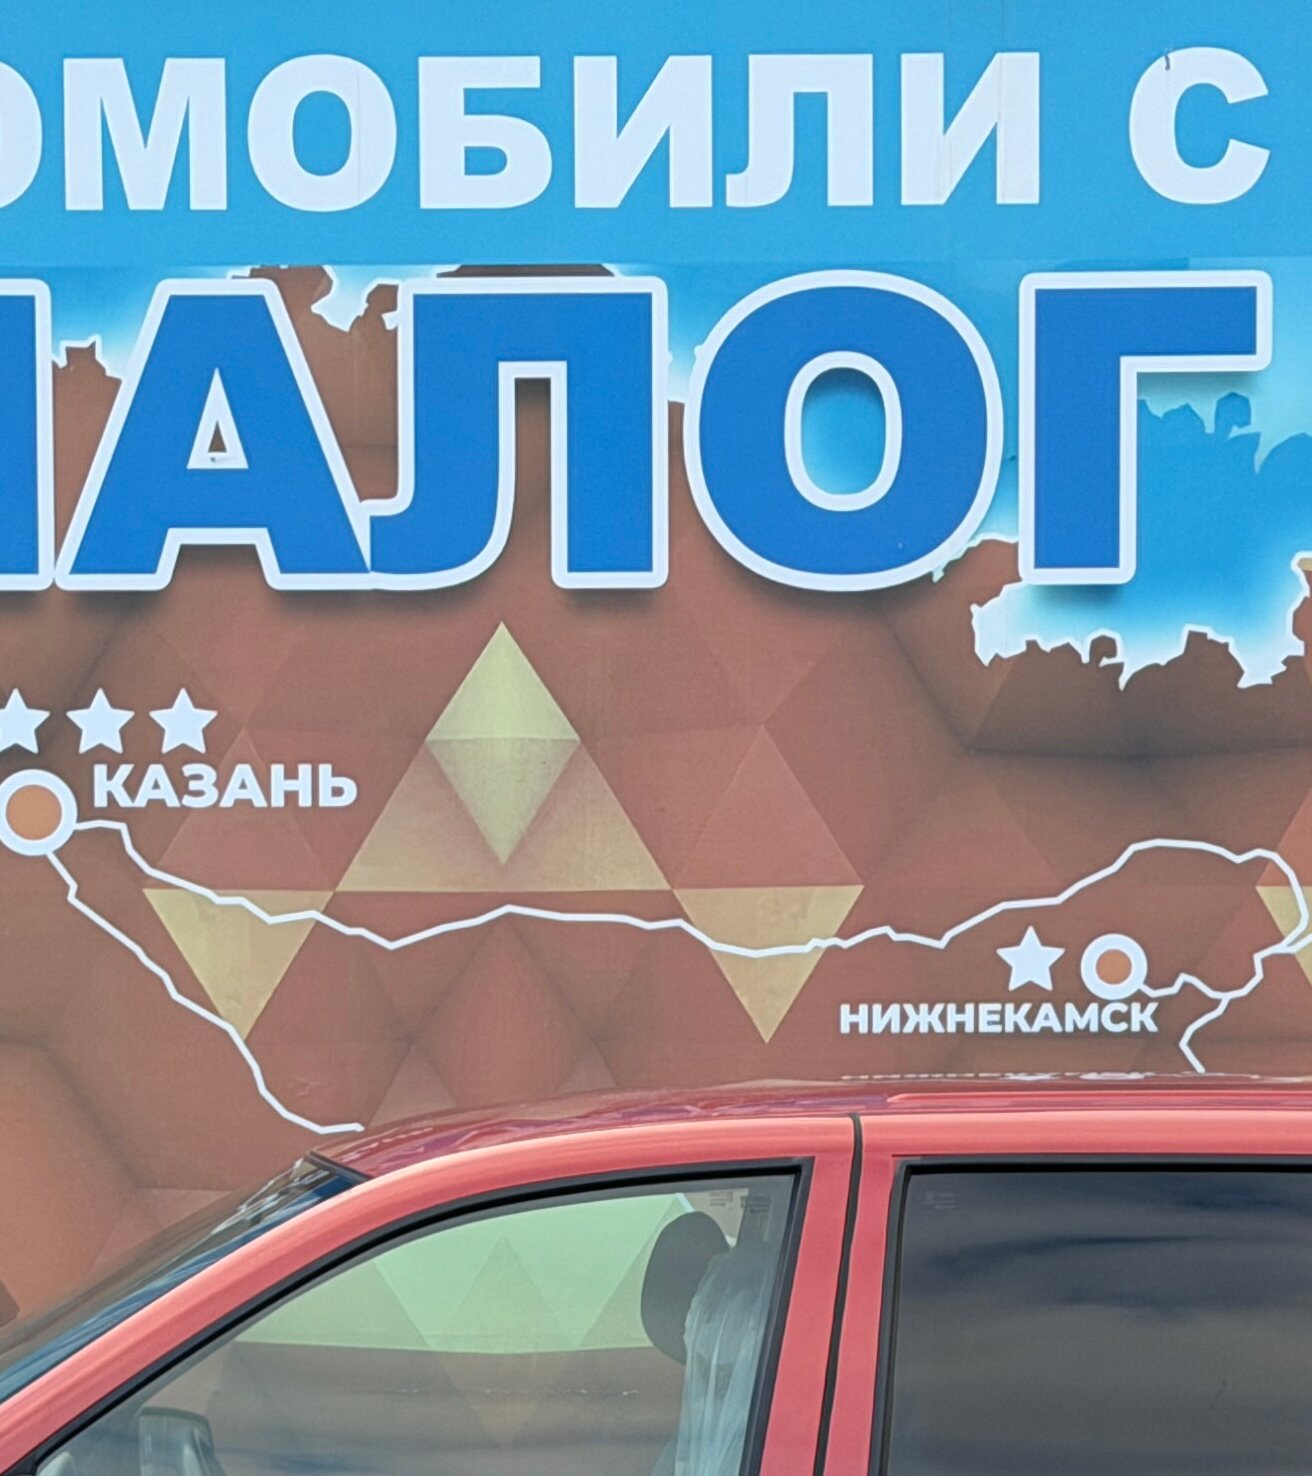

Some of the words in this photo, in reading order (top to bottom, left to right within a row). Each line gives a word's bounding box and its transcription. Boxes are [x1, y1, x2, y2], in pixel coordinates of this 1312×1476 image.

[1129, 48, 1270, 204] С
[93, 763, 358, 809] КАЗАНЬ
[839, 1001, 1159, 1034] НИЖНЕКАМСК
